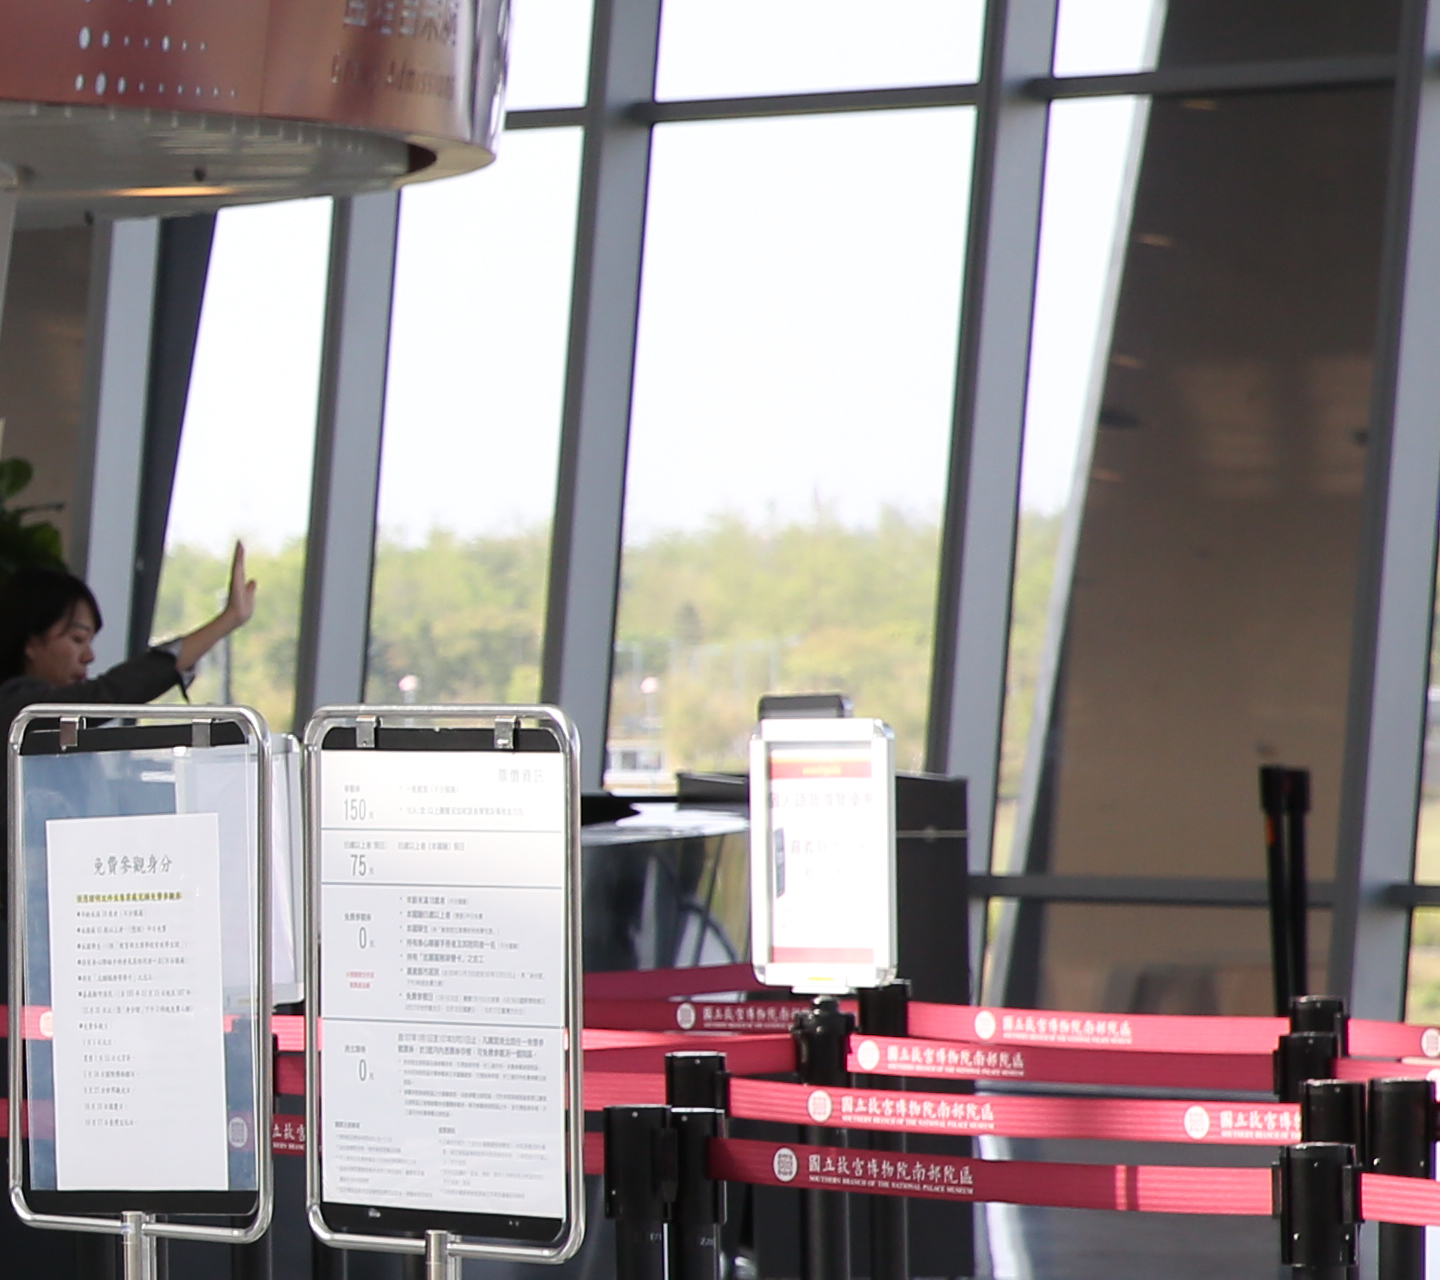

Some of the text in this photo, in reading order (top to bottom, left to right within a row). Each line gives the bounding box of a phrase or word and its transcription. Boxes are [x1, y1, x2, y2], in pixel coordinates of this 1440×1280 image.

[343, 797, 367, 821] 150
[93, 853, 173, 876] 免費參觀身分
[349, 854, 368, 877] 75
[359, 926, 367, 950] 0
[887, 1045, 1024, 1069] 國立故宮博物院南部院區
[359, 1058, 367, 1082] 0
[841, 1095, 995, 1122] 國立故宮博物院南部院區
[808, 1154, 974, 1185] 國立故宮博物院南部院區
[808, 1175, 974, 1194] SOUTHERN BRANCH OF THE NATIONAL PALACE MUSEUM
